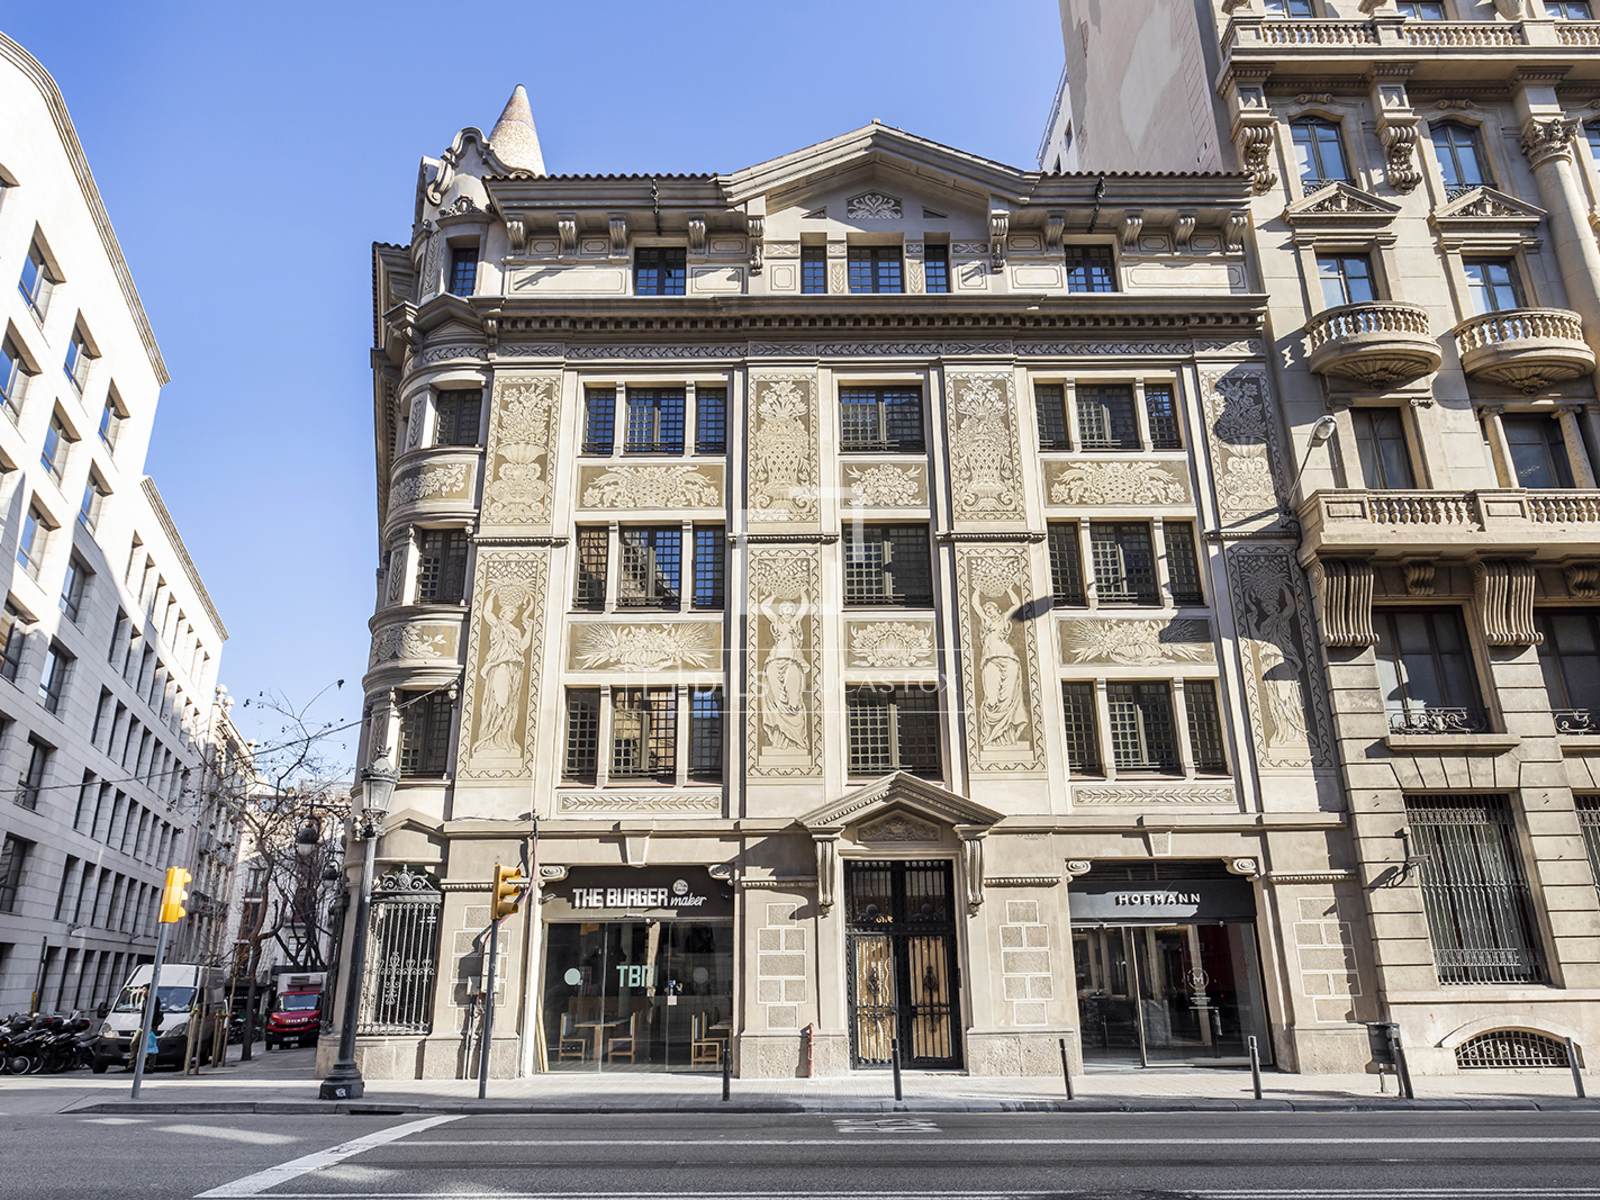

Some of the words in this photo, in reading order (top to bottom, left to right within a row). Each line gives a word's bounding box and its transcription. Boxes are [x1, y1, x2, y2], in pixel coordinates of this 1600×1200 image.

[572, 888, 604, 907] THE
[606, 888, 668, 907] BURGER
[670, 893, 707, 907] maker
[1118, 893, 1201, 904] HOFMANN
